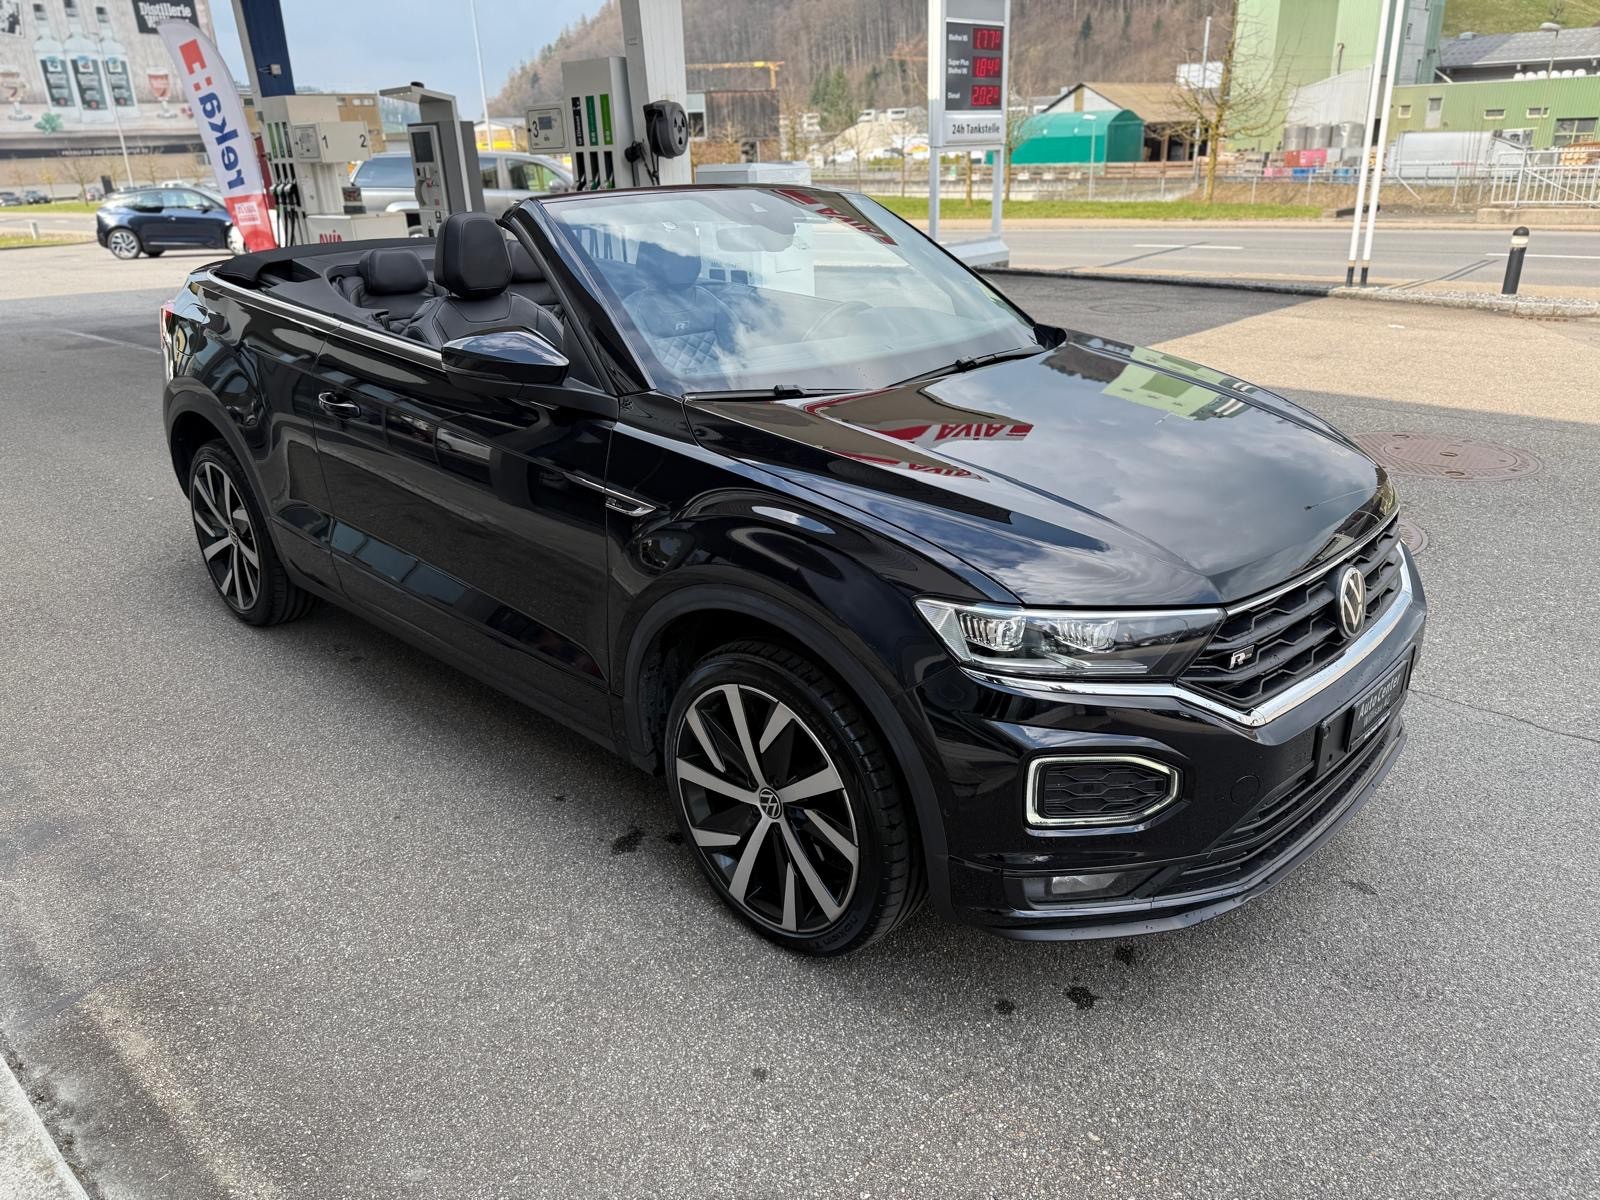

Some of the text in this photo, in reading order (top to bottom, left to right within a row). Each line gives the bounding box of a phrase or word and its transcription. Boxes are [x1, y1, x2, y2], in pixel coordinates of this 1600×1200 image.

[139, 2, 192, 17] Distillerie
[532, 120, 539, 138] 3
[952, 122, 1000, 135] 24h Tankstelle
[322, 134, 329, 149] 1
[360, 134, 368, 148] 2
[1358, 673, 1401, 721] Auto Center
